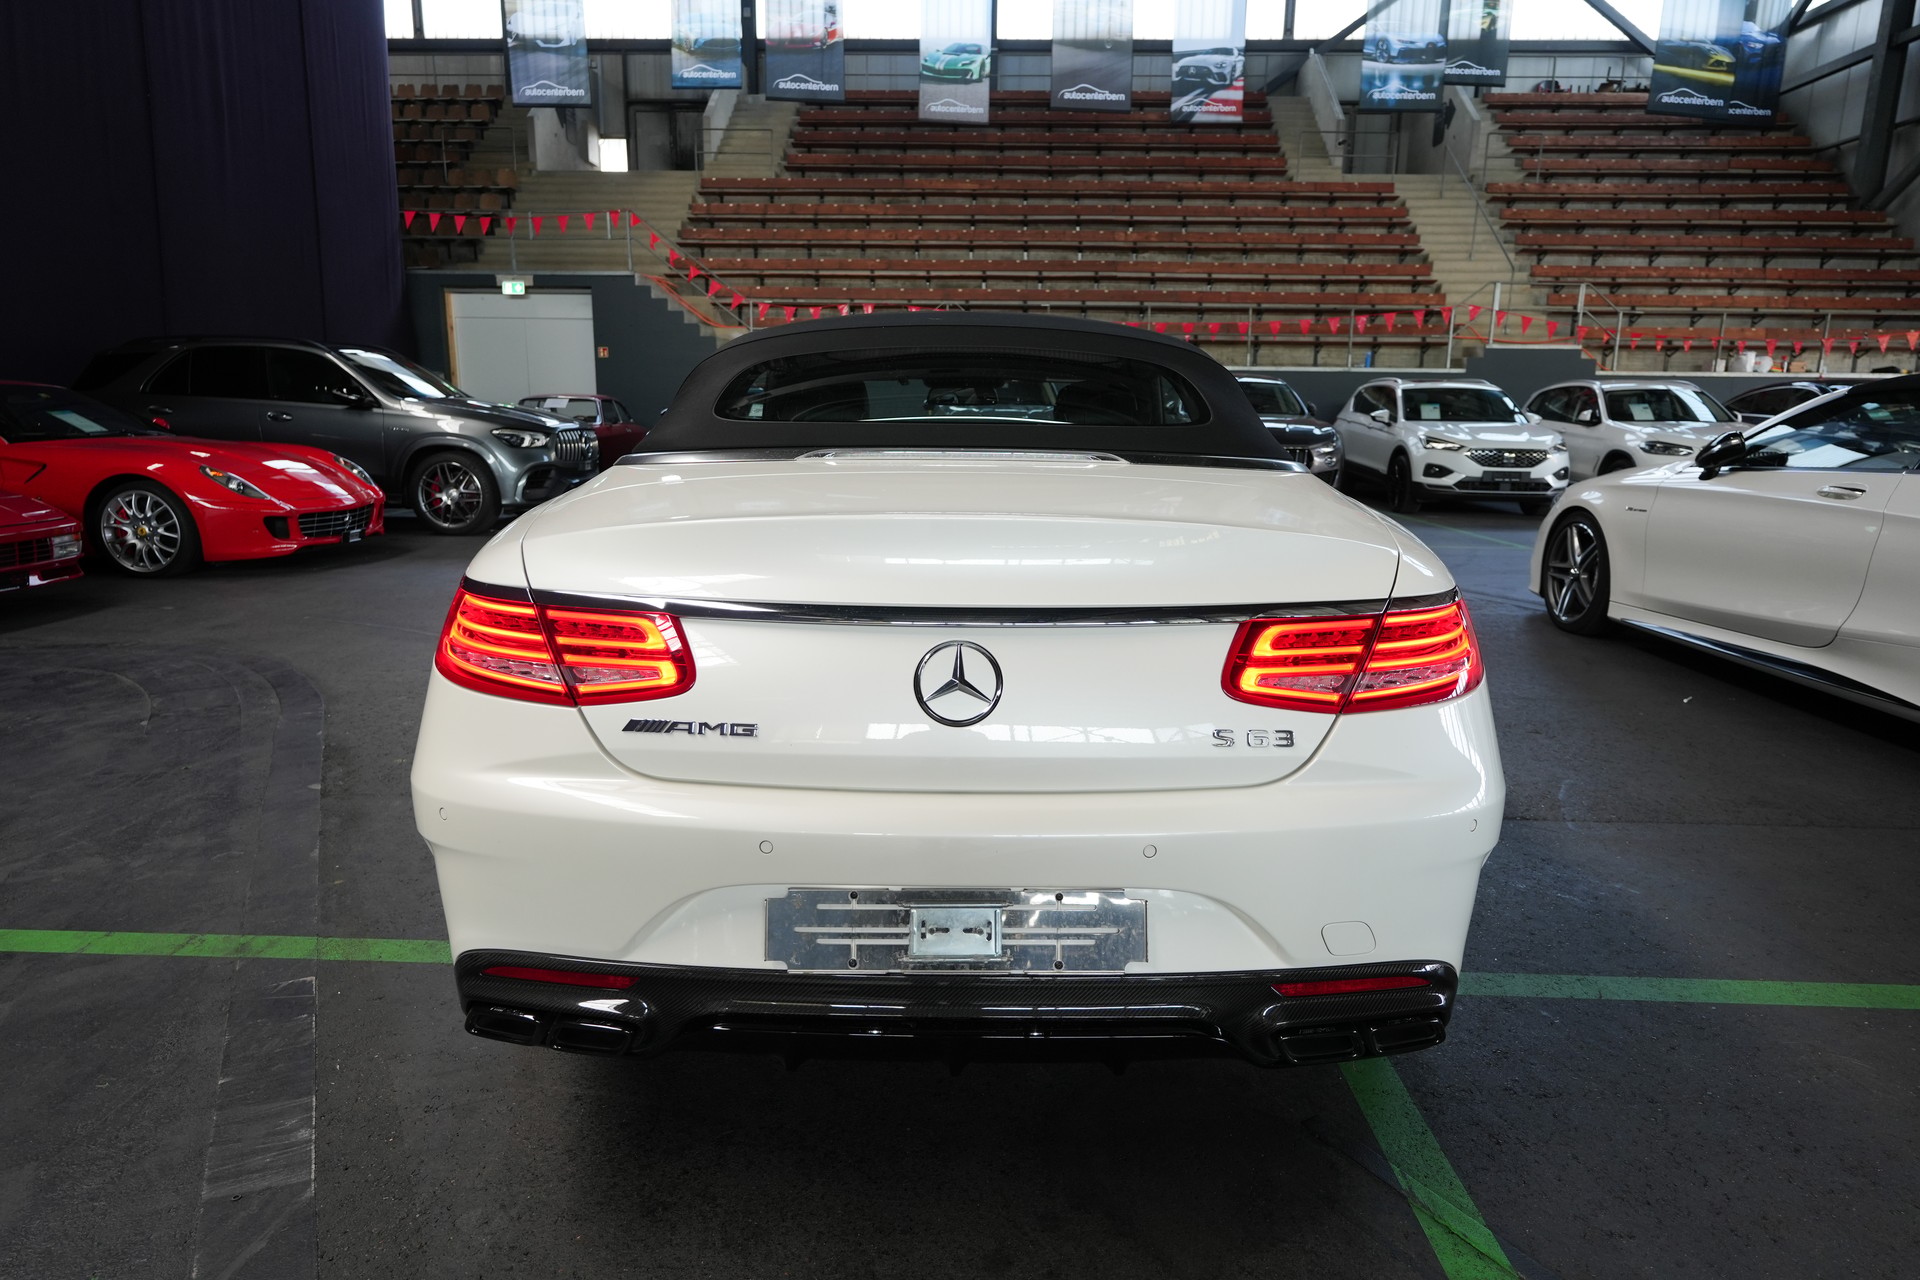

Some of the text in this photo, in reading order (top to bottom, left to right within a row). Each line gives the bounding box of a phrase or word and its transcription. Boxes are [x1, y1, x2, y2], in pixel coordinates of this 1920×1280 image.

[682, 71, 737, 79] autocenterbern
[1444, 67, 1501, 76] autocenterbern
[778, 81, 839, 91] autocenterbern
[525, 88, 585, 97] autocenterbern
[1063, 91, 1126, 101] autocenterbern
[1372, 91, 1436, 100] autocenterbern
[1661, 95, 1724, 107] autocenterbern
[930, 105, 984, 114] autocenterbern
[663, 720, 759, 738] AMG
[1211, 728, 1296, 749] S 63
